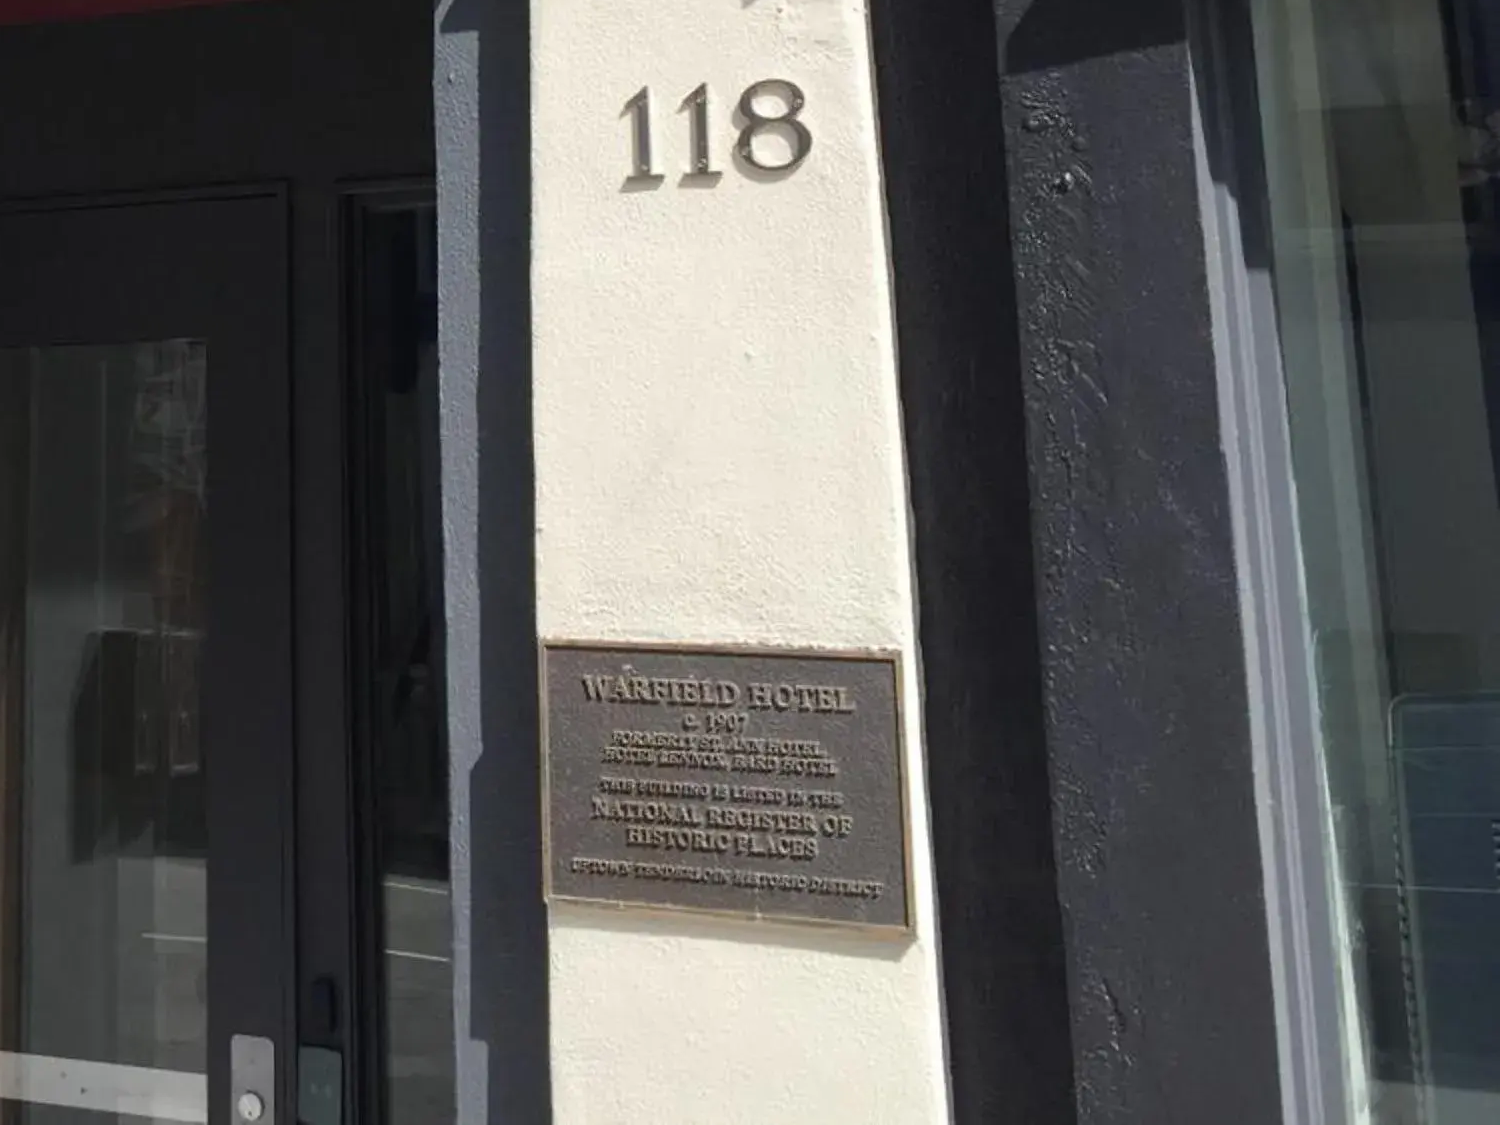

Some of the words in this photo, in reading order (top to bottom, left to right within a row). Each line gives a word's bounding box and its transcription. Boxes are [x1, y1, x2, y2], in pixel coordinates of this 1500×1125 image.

[619, 79, 812, 192] 118
[582, 674, 741, 707] WARFIELD
[747, 682, 856, 714] HOTEL
[590, 795, 703, 828] NATIONAL
[706, 806, 819, 836] REGISTER
[821, 814, 854, 838] OF
[626, 824, 731, 853] HISTORIC
[734, 831, 819, 861] PLACES
